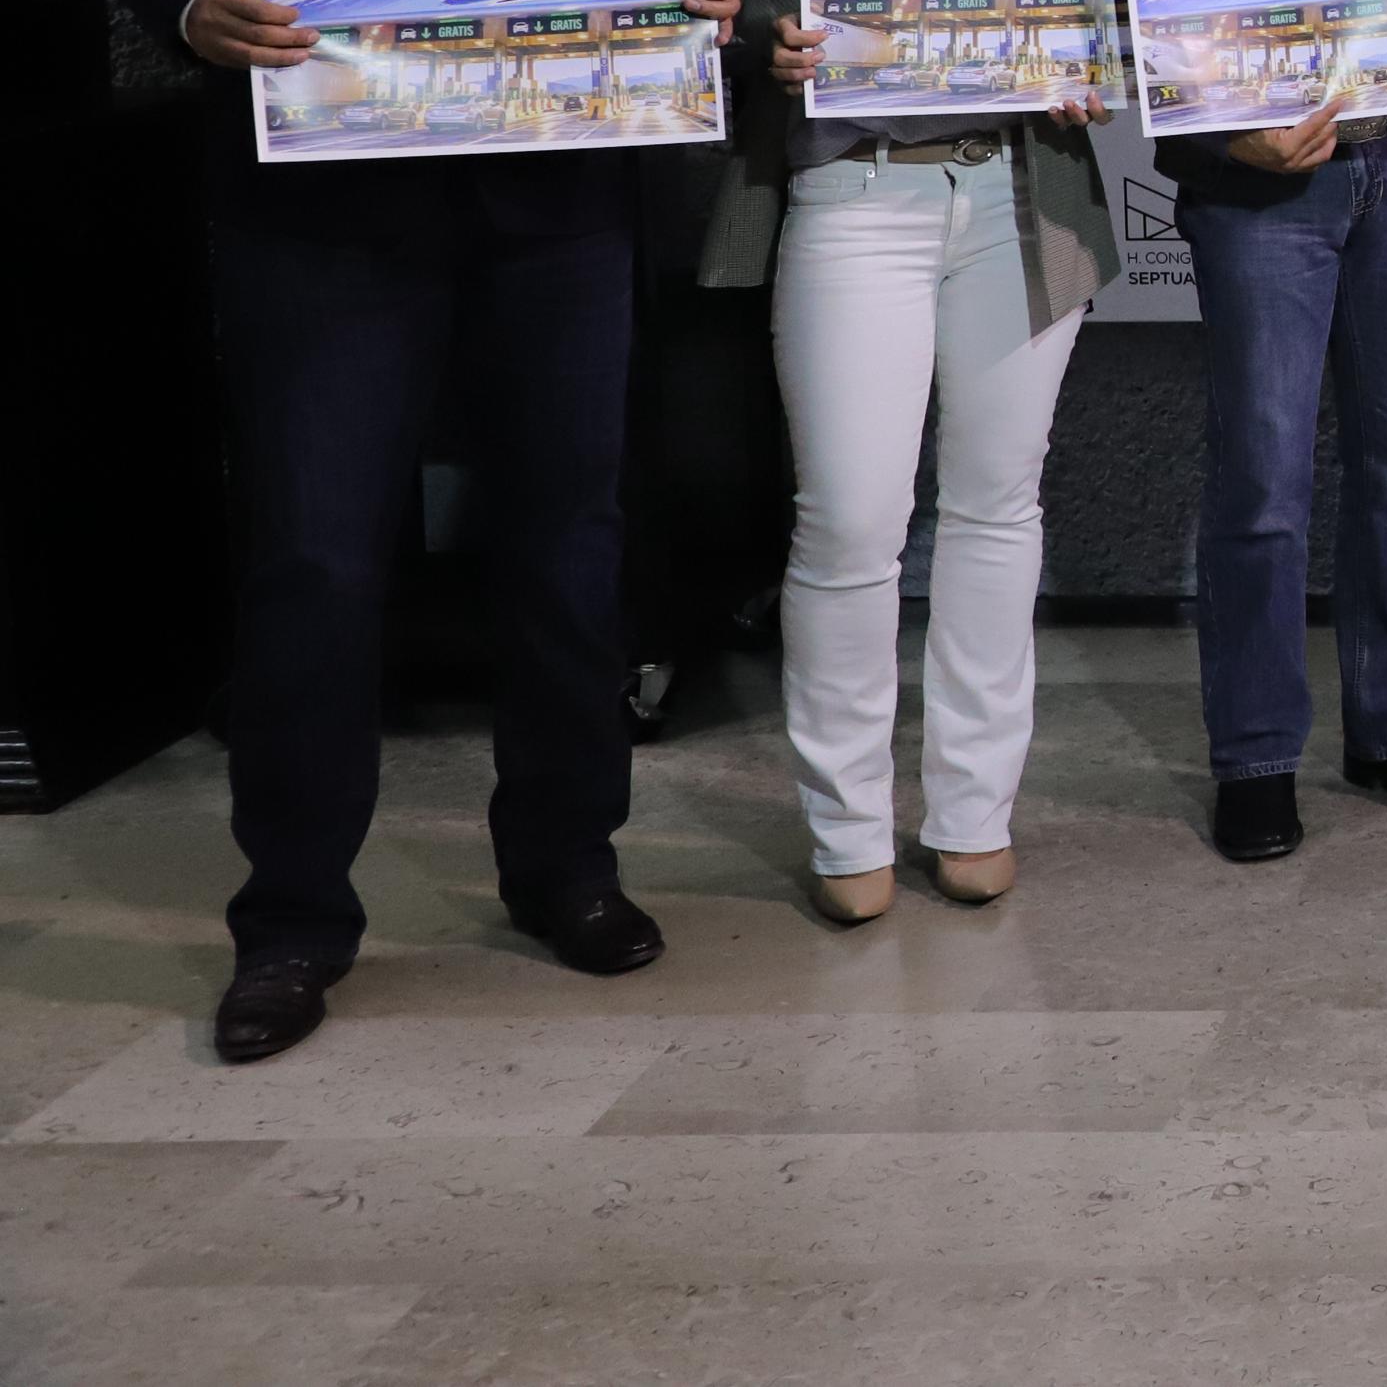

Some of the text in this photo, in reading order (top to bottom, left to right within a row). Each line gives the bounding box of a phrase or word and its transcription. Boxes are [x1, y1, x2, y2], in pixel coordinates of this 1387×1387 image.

[550, 16, 583, 32] GRATIS
[654, 9, 689, 25] GRATIS
[438, 24, 474, 39] GRATIS
